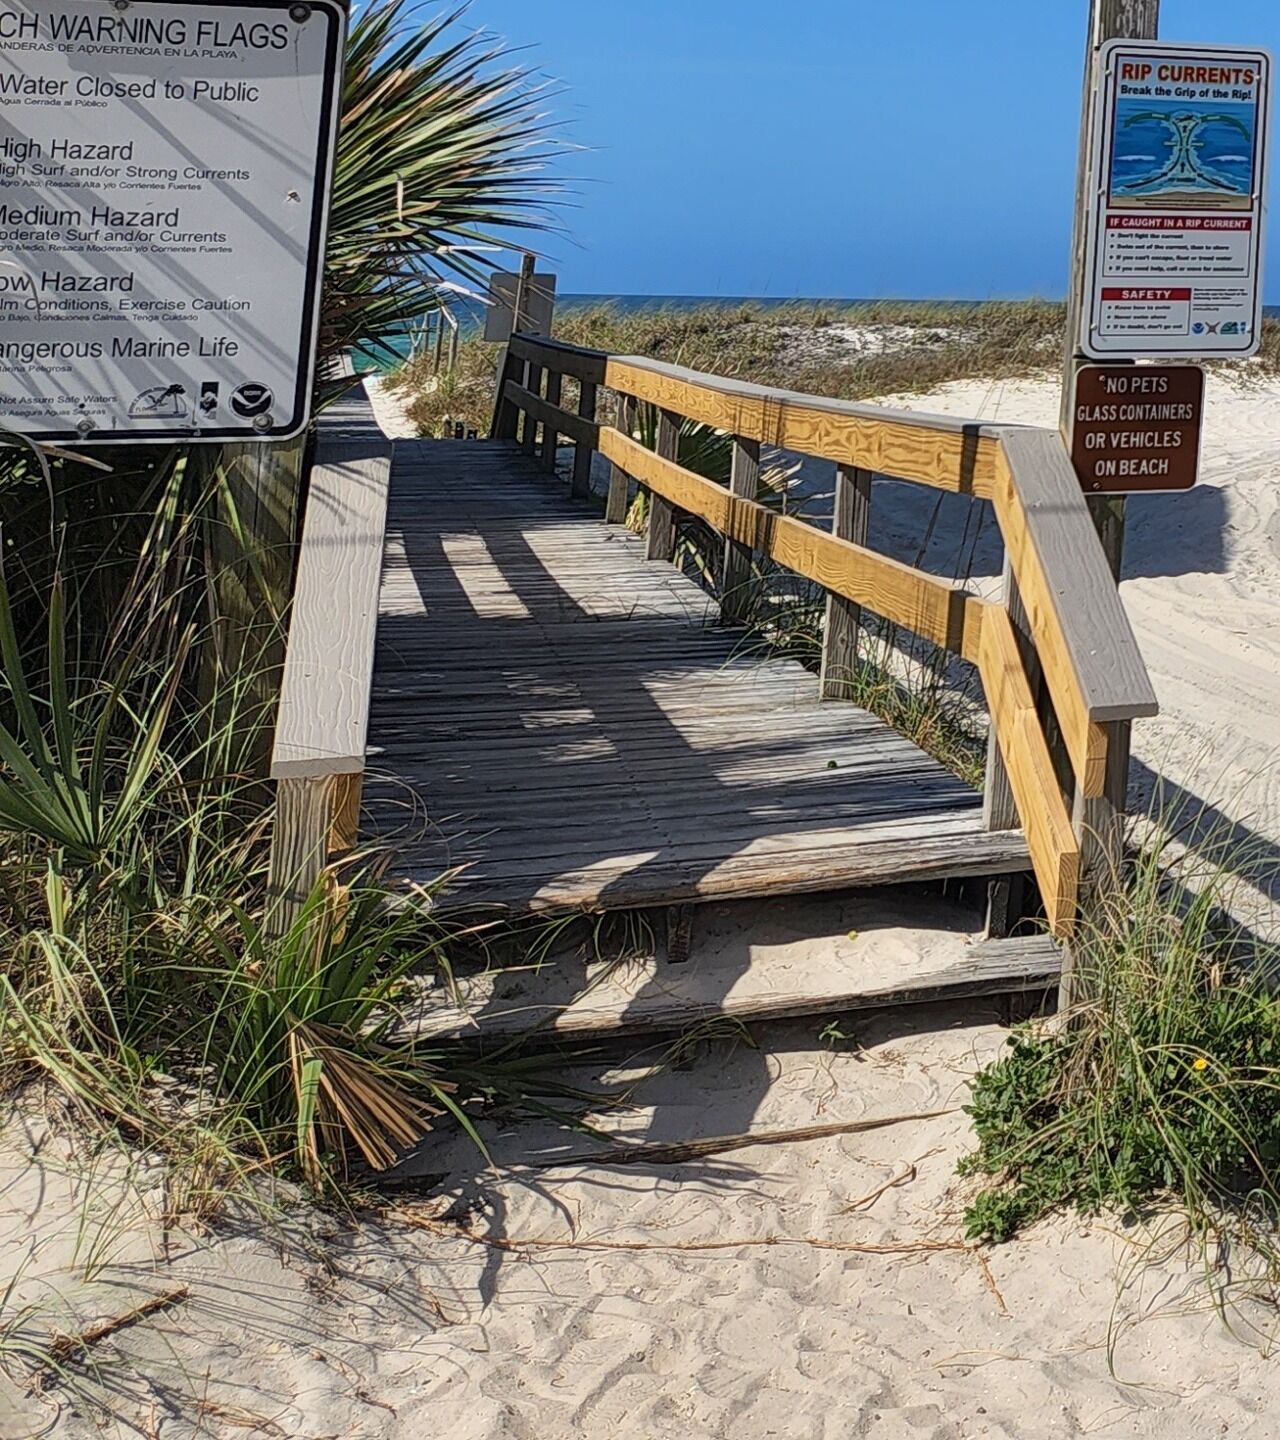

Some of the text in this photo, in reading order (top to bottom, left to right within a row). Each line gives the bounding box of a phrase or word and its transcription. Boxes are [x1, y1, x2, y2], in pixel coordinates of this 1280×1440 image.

[49, 14, 186, 45] WARNING
[196, 20, 289, 49] FLAGS
[58, 43, 74, 54] DE
[77, 44, 161, 57] ADVERTENCIA
[165, 47, 180, 57] EN
[184, 48, 199, 58] LA
[202, 49, 238, 59] PLAYA
[1122, 63, 1254, 84] RIP CURRENTS
[0, 73, 259, 102] Water Closed to Public
[1121, 85, 1252, 101] Break the Grip of the Rip!
[51, 138, 133, 161] Hazard
[0, 163, 250, 181] igh Surf and/or Strong Currents
[91, 206, 179, 227] Hazard
[1110, 218, 1248, 228] IF CAUGHT IN A RIP CURRENT
[65, 230, 100, 242] Surf
[104, 230, 154, 242] and/or
[159, 230, 227, 243] Currents
[41, 272, 134, 292] Hazard
[1122, 290, 1171, 298] SAFETY
[24, 298, 112, 313] Conditions,
[119, 298, 186, 310] Exercise
[191, 298, 250, 310] Caution
[112, 337, 190, 357] Marine
[199, 337, 239, 356] Life
[1107, 377, 1168, 393] NO PETS
[1077, 404, 1193, 421] GLASS CONTAINERS
[1085, 431, 1182, 448] OR VEHICLES
[1095, 459, 1168, 476] ON BEACH
